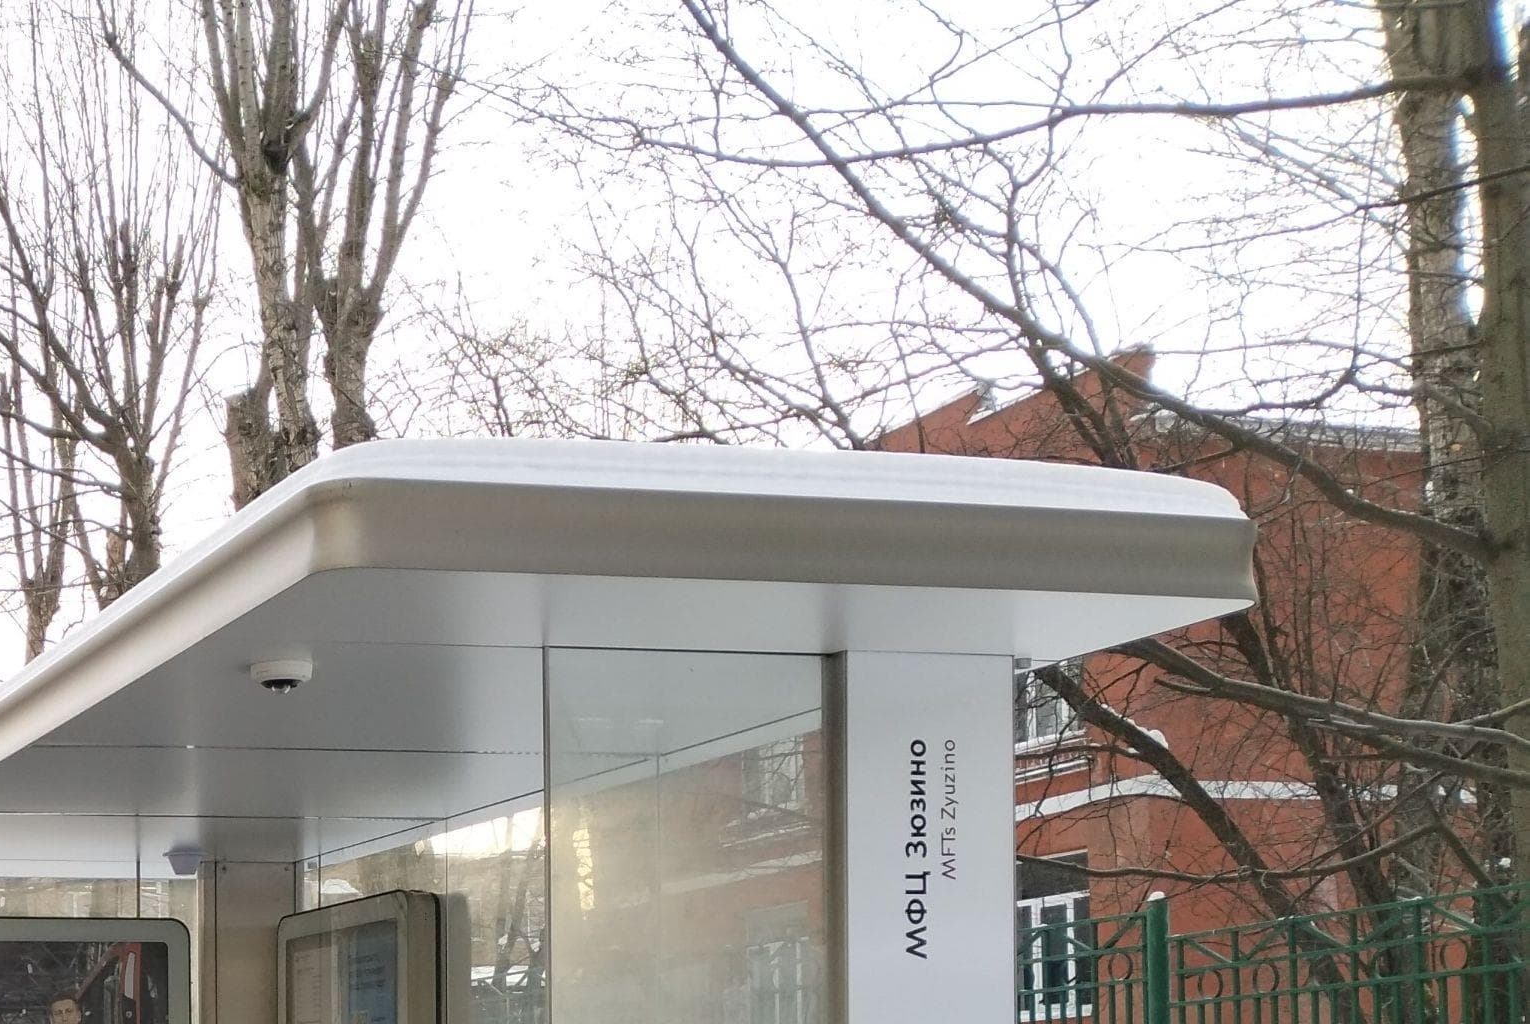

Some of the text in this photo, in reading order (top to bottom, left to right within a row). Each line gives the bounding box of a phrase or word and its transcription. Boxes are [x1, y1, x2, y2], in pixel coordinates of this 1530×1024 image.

[905, 739, 931, 959] МФЦ Зюзино
[941, 739, 959, 880] MFTs Zyuzino
